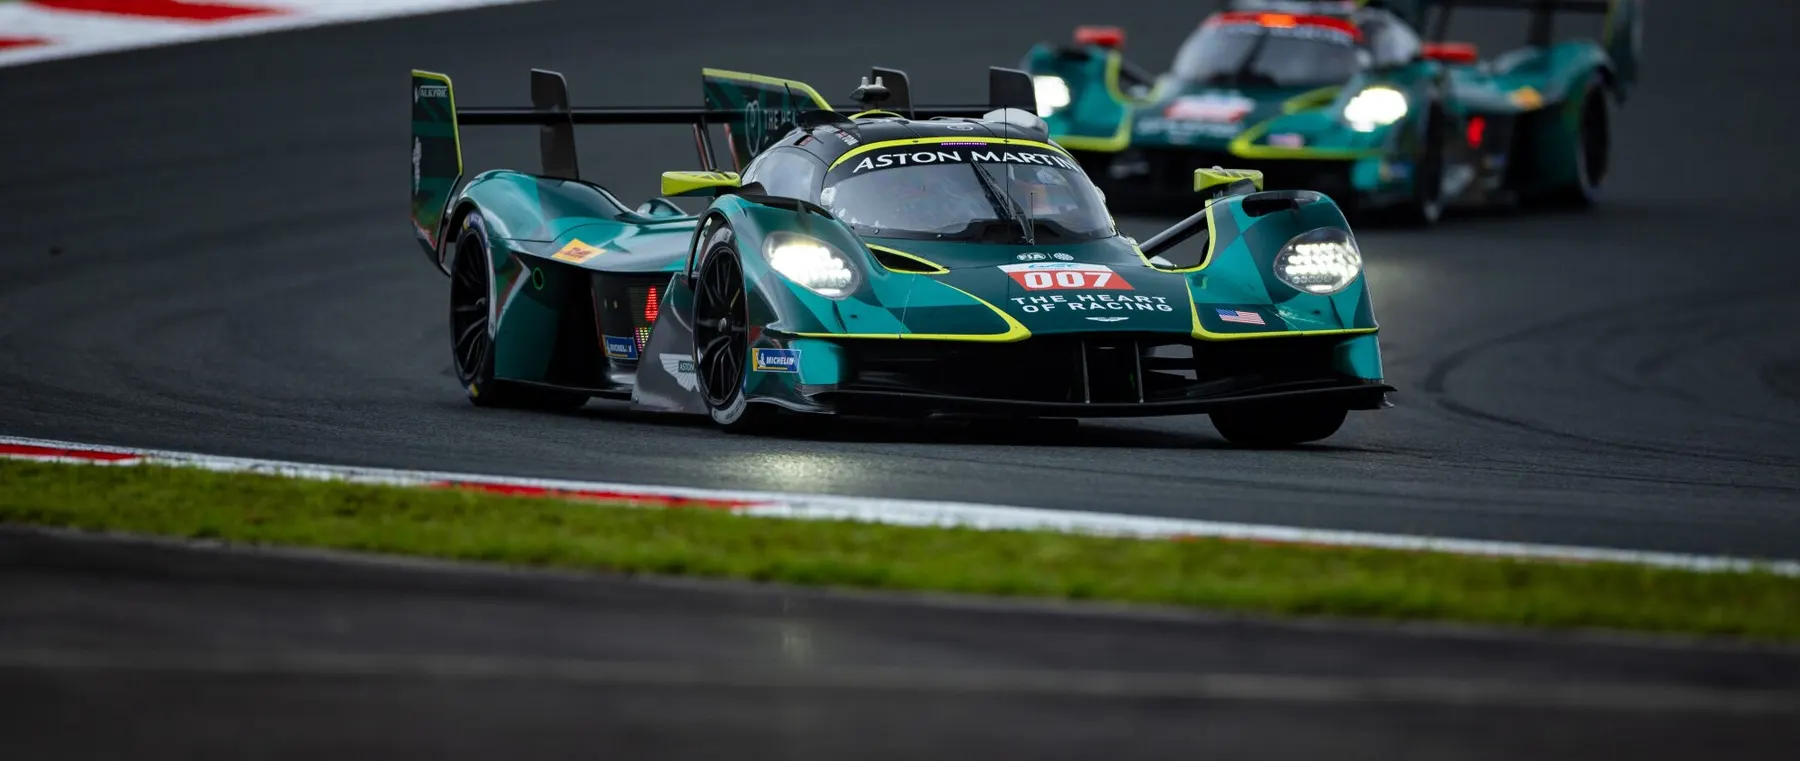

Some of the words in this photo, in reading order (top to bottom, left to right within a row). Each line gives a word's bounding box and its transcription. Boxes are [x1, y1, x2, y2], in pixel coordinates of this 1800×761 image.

[764, 109, 780, 130] THE
[852, 150, 962, 174] ASTON
[971, 150, 1080, 173] MARTIN
[1023, 272, 1112, 288] 007
[1011, 295, 1067, 305] THE
[1076, 294, 1166, 304] HEART
[1022, 303, 1056, 313] OF
[1068, 302, 1173, 312] RACING
[766, 356, 795, 366] MICHELIN
[679, 363, 695, 371] ASTON
